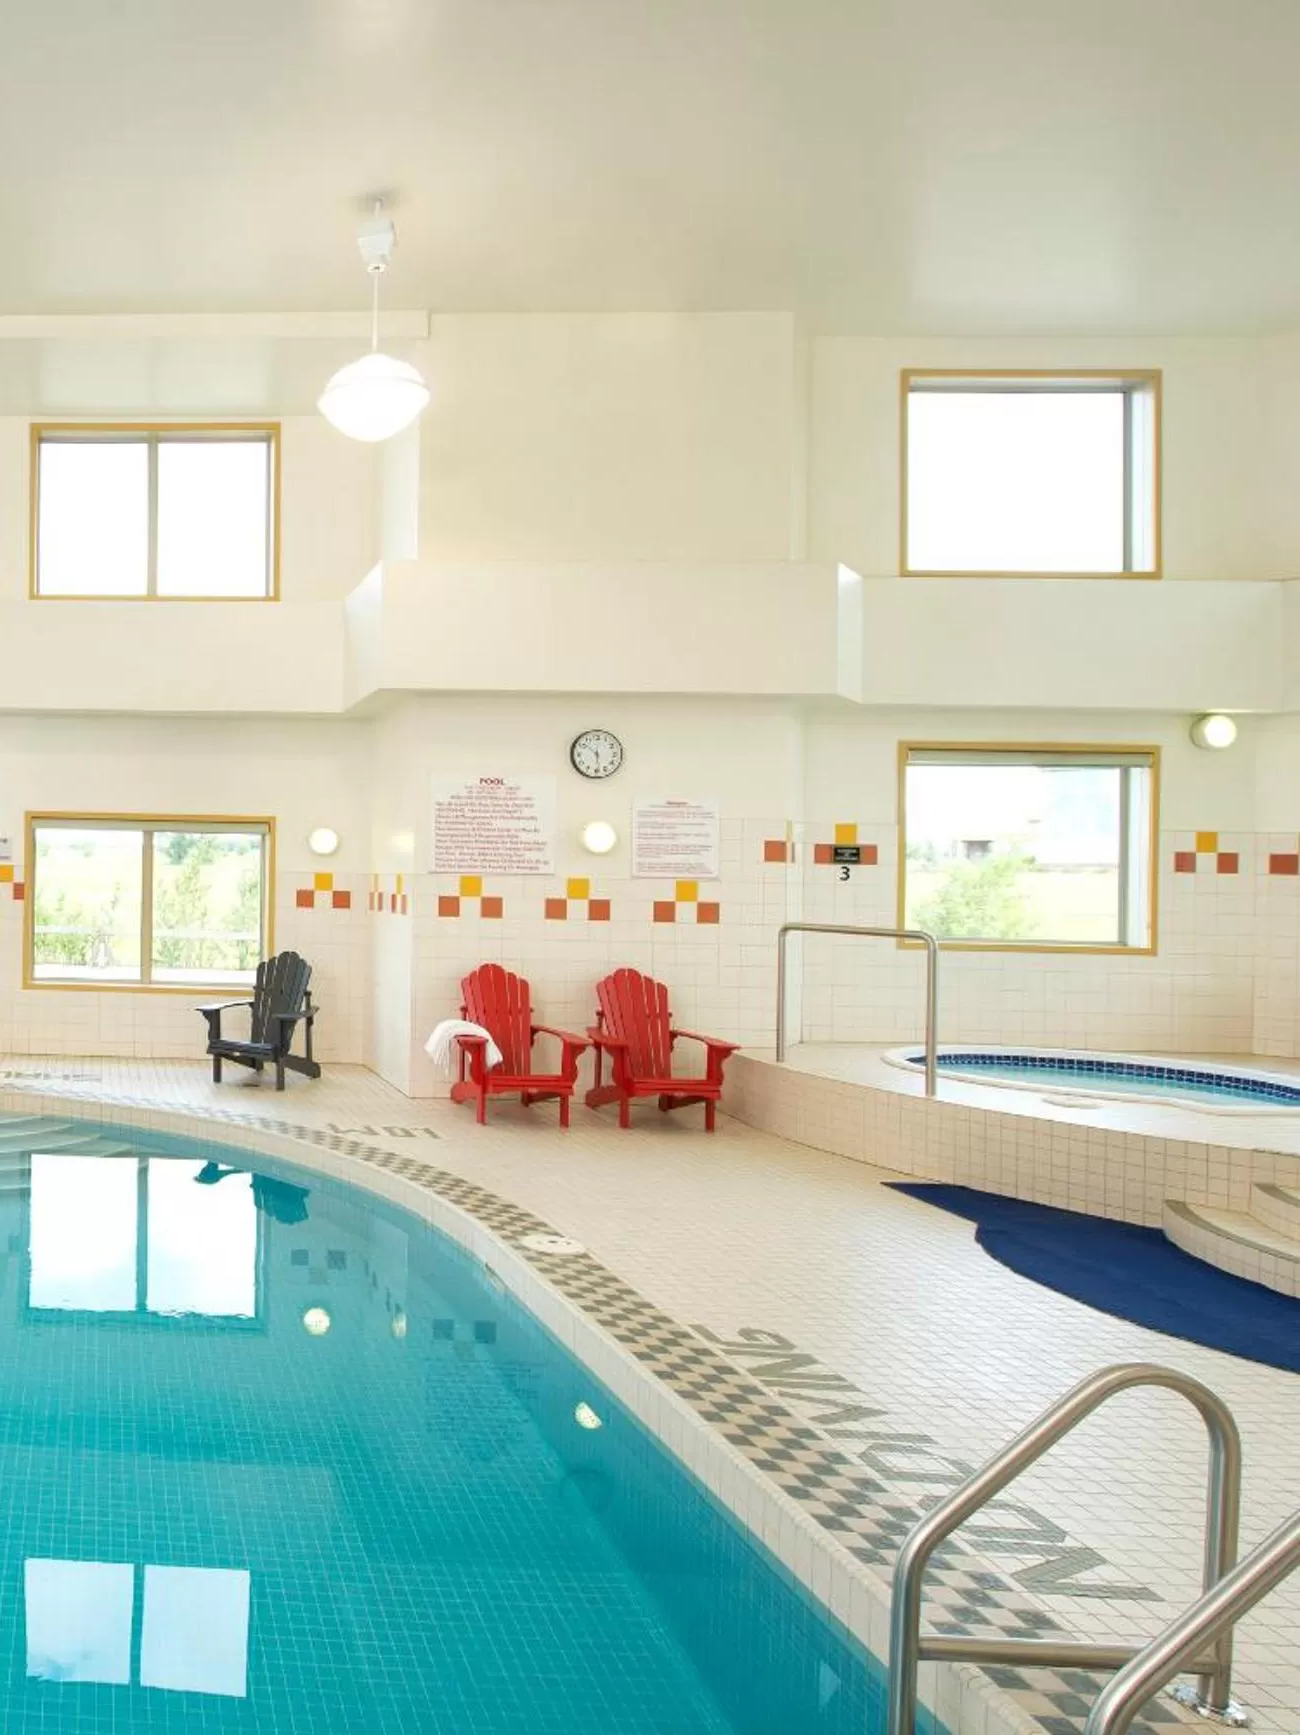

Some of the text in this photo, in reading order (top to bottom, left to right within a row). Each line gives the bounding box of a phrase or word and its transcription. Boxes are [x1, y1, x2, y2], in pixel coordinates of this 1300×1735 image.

[479, 777, 504, 786] POOL
[839, 866, 851, 881] 3
[687, 1323, 1166, 1602] NO DIVING
